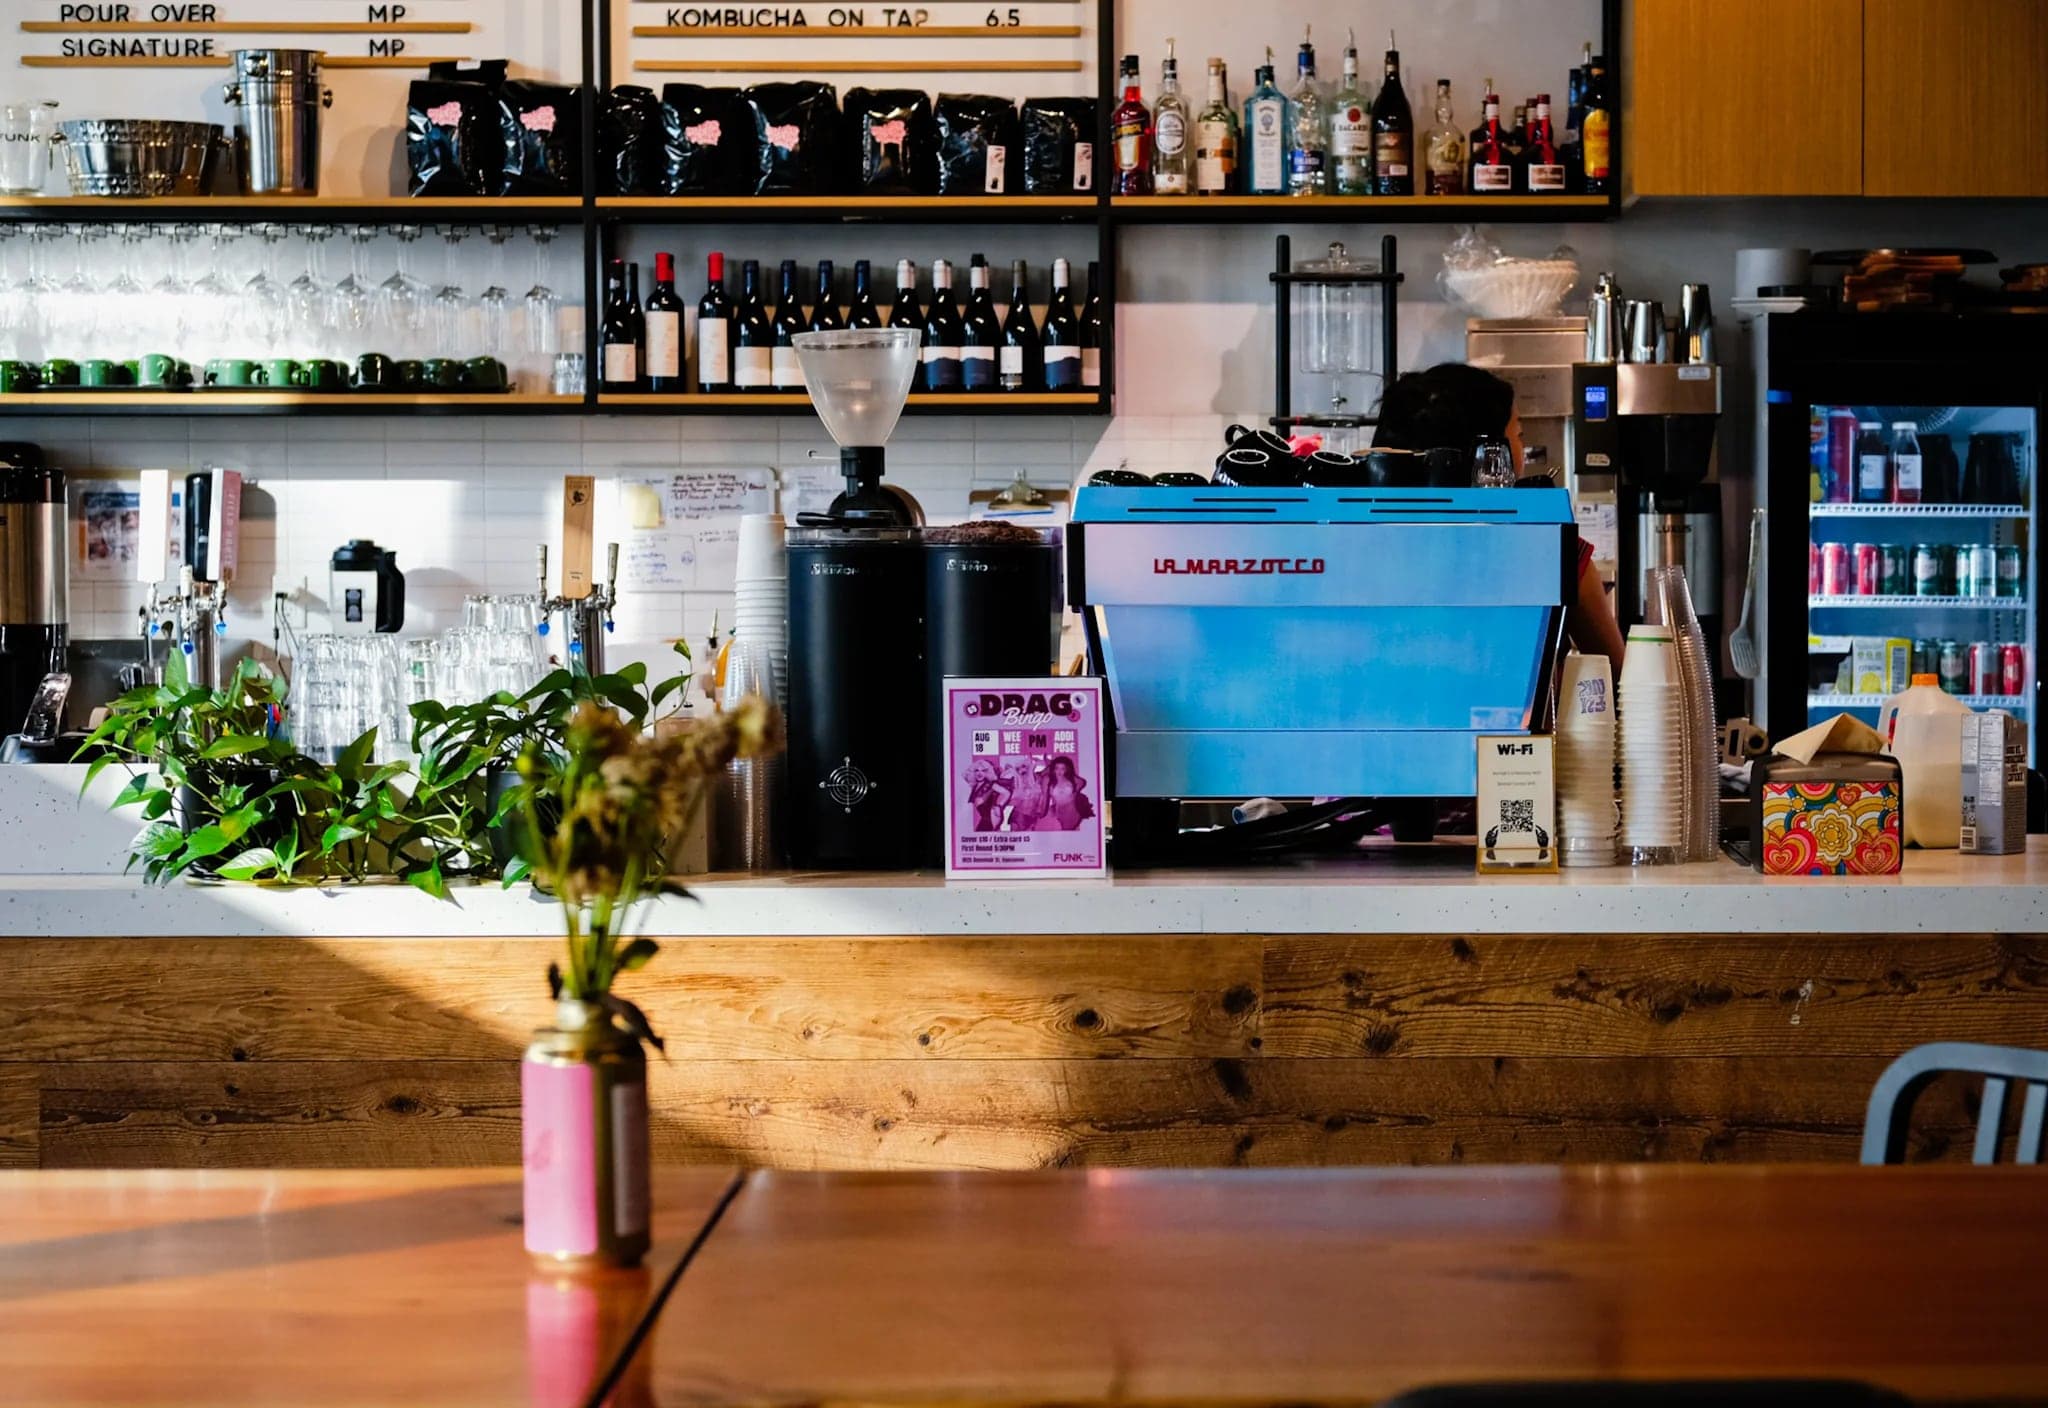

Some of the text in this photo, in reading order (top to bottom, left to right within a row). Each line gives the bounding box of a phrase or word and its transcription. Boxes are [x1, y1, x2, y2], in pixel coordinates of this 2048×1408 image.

[60, 4, 216, 22] POUR OVER
[368, 4, 406, 23] MP
[667, 9, 929, 27] KOMBUCHA ON TAP
[986, 9, 1020, 27] 6.5
[62, 38, 215, 57] SIGNATURE
[369, 38, 405, 57] MP
[1153, 558, 1325, 574] LA MARZOCCO
[979, 693, 1073, 717] DRAG
[1003, 706, 1053, 731] Bingo
[974, 732, 991, 742] AUG
[1002, 730, 1022, 742] WEE
[1028, 734, 1047, 748] PM
[974, 743, 984, 752] 18
[1053, 742, 1076, 753] POSE
[1496, 743, 1533, 755] Wi-Fi
[1053, 853, 1083, 862] FUNK
